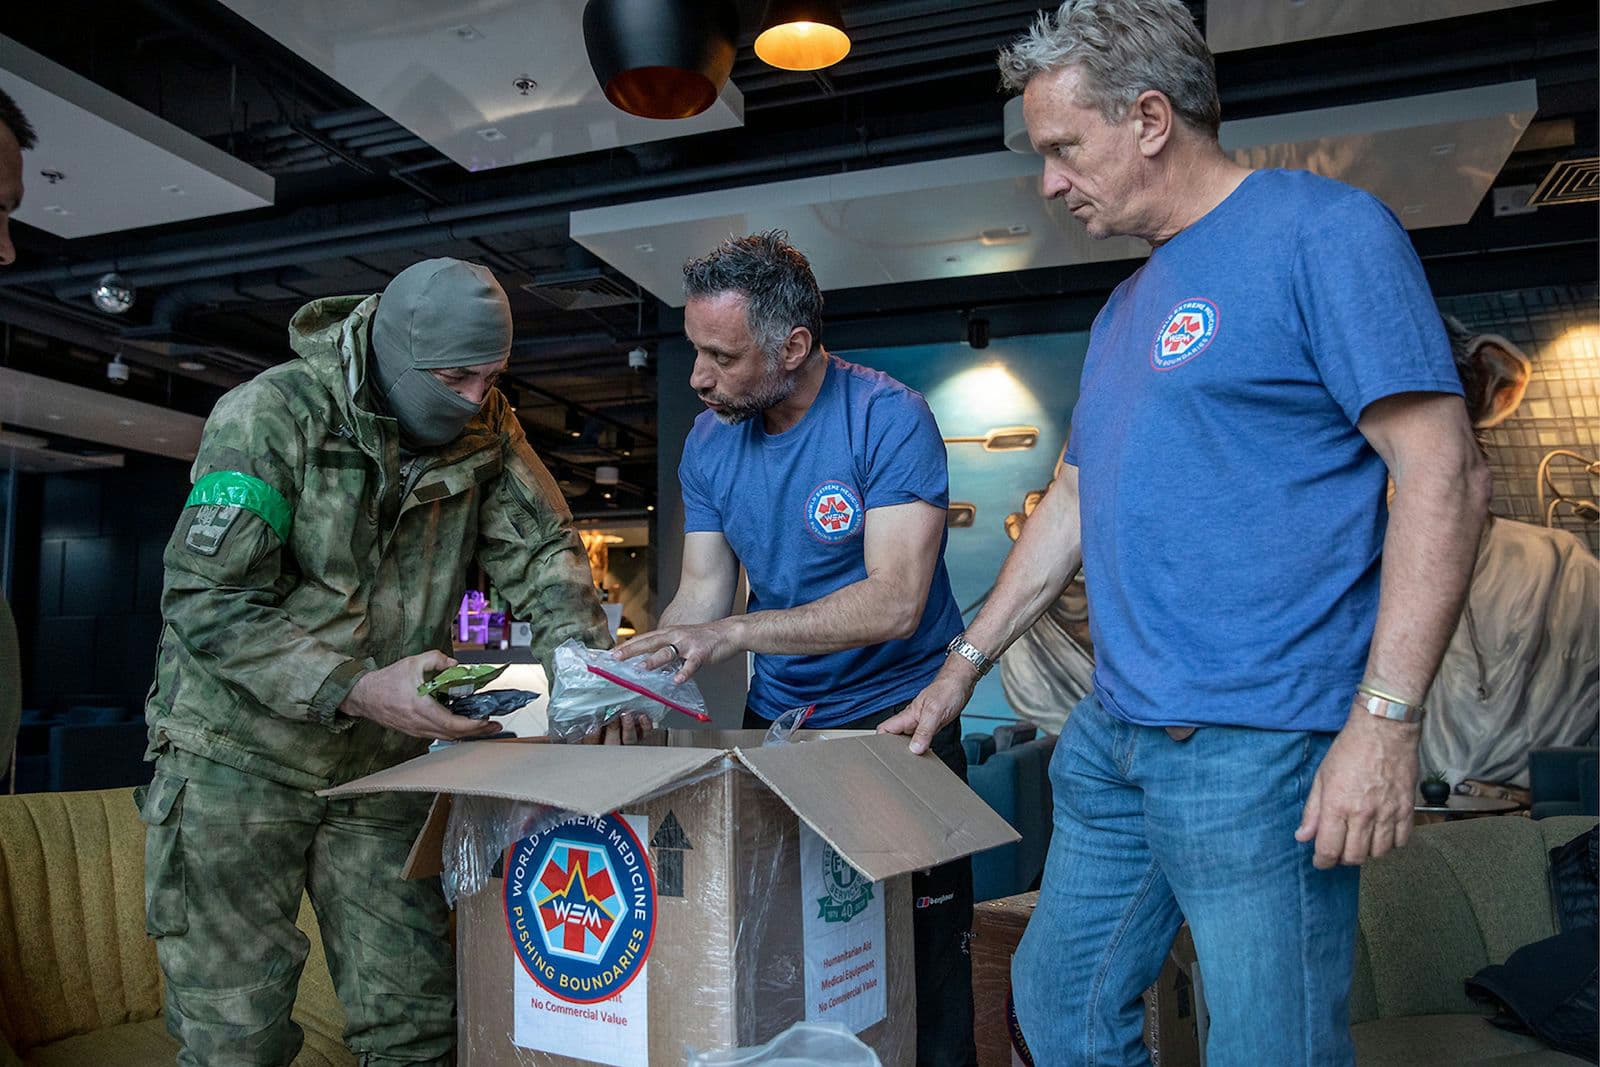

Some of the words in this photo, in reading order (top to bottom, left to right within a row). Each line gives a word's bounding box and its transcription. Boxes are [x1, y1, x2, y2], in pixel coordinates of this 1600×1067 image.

[1173, 302, 1206, 315] EXTREME
[1163, 338, 1208, 366] BOUNDARIES
[815, 484, 840, 498] EXTREME
[840, 487, 861, 512] MEDICINE
[824, 512, 846, 522] WEM
[512, 832, 540, 898] WORLD
[608, 830, 647, 921] MEDICINE
[552, 898, 603, 930] WEM
[841, 903, 853, 918] 40
[512, 906, 556, 980] PUSHING
[559, 928, 645, 992] BOUNDARIES
[823, 946, 862, 969] Humanitarian
[863, 939, 872, 953] Aid
[821, 971, 845, 991] Medical
[845, 959, 875, 980] Equipment
[818, 1001, 828, 1013] No
[828, 985, 862, 1008] Commercial
[862, 978, 878, 992] Value
[531, 997, 544, 1010] No
[545, 1000, 599, 1021] Commercial
[600, 1011, 628, 1026] Value
